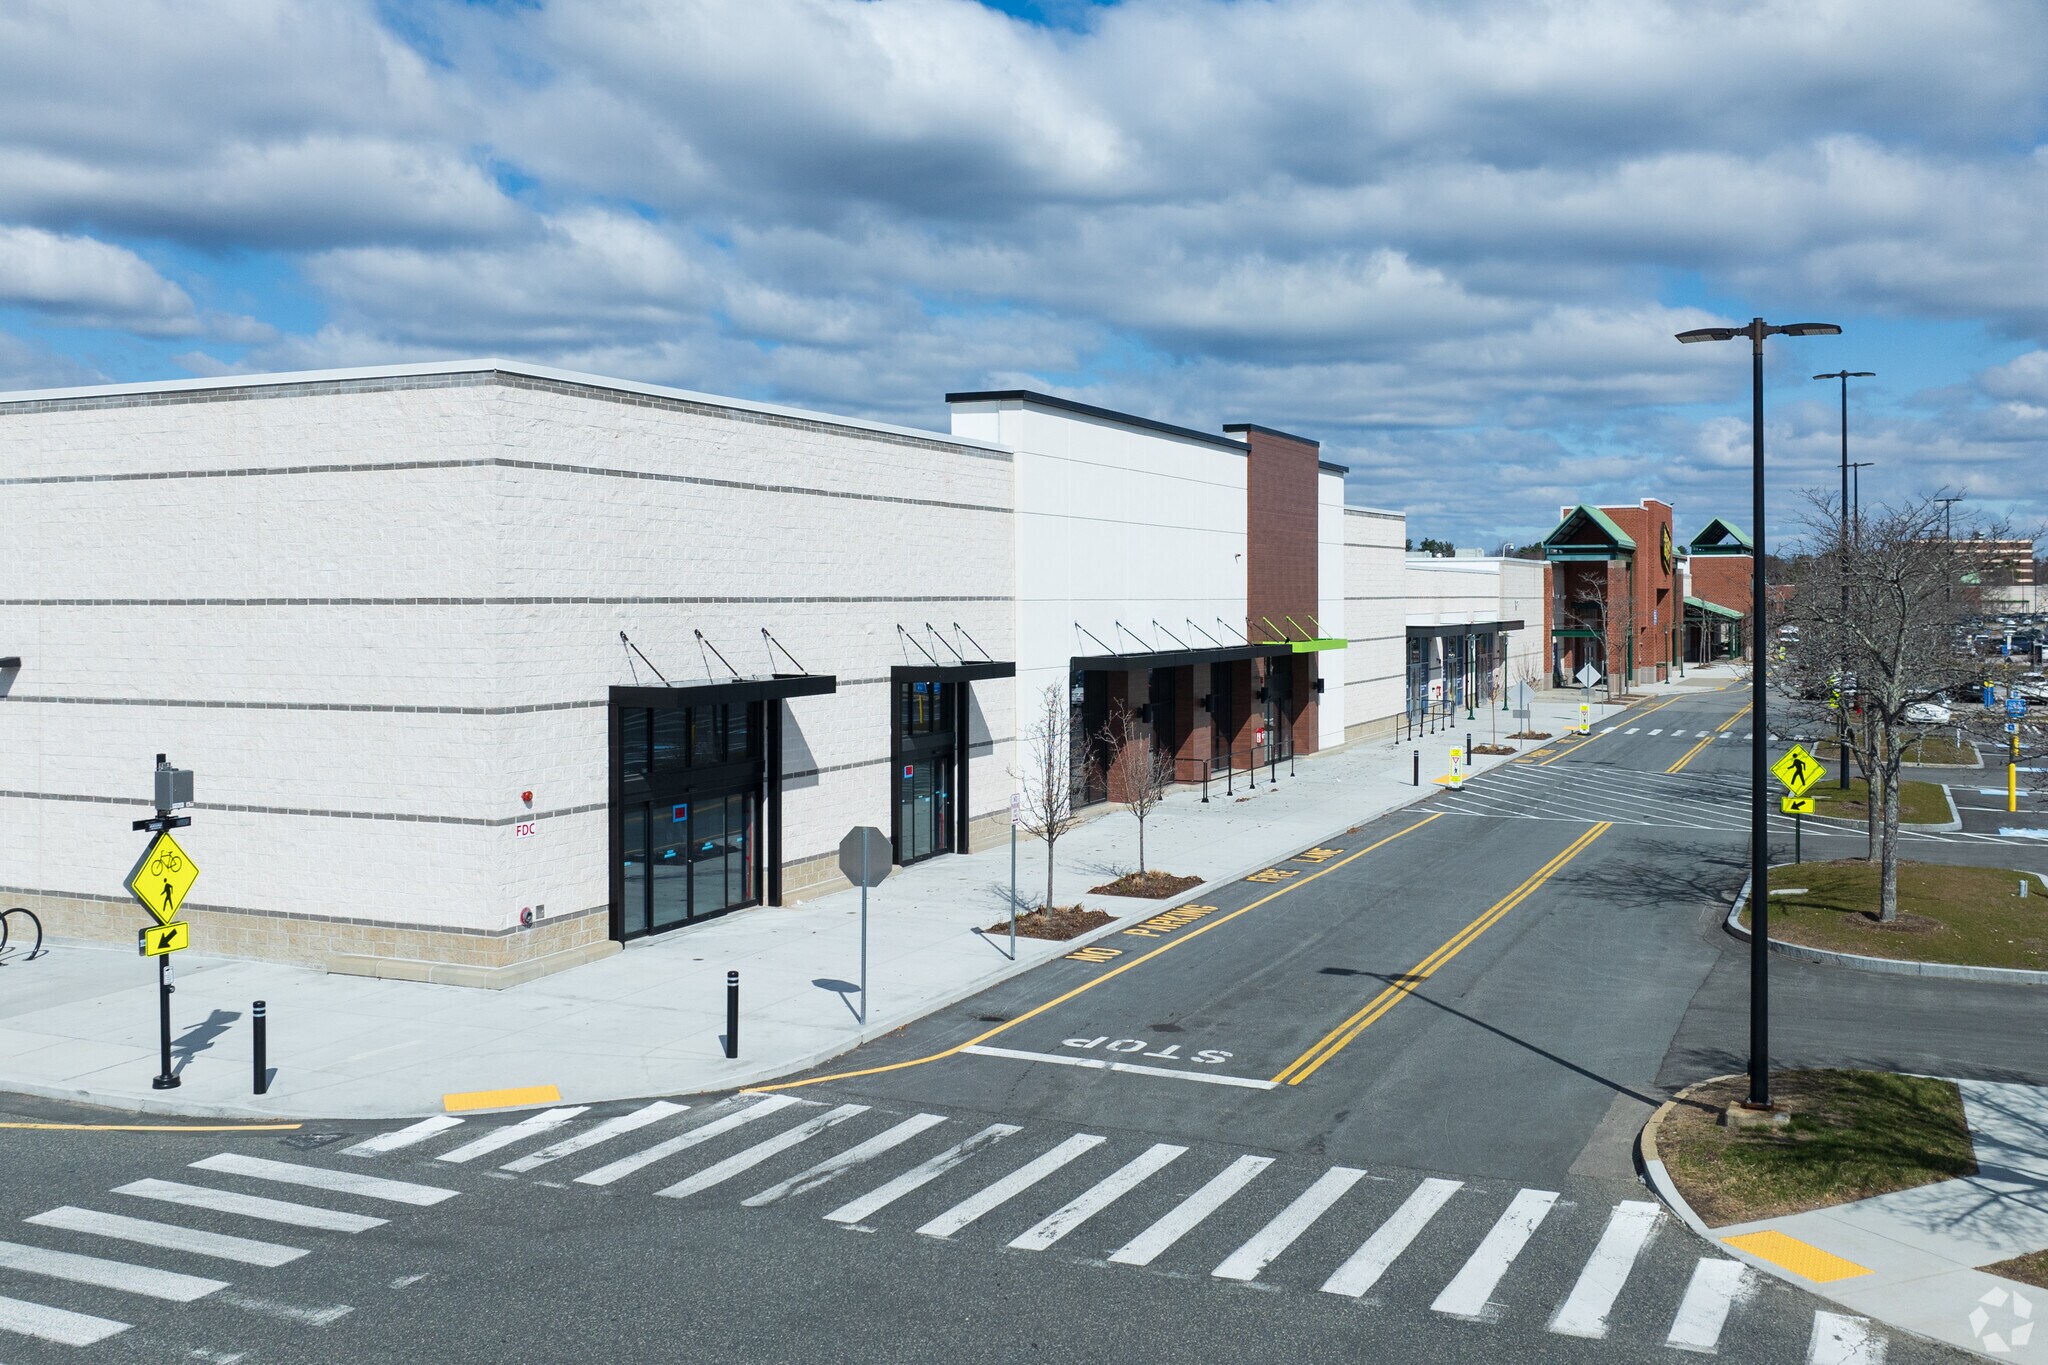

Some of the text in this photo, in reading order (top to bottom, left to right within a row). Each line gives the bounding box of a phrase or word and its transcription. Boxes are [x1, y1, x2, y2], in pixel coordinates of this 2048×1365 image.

[516, 823, 535, 837] FDC
[1065, 947, 1123, 963] NO
[1123, 904, 1219, 938] PARKING
[1246, 868, 1300, 884] FIRE
[1061, 1036, 1234, 1064] STOP
